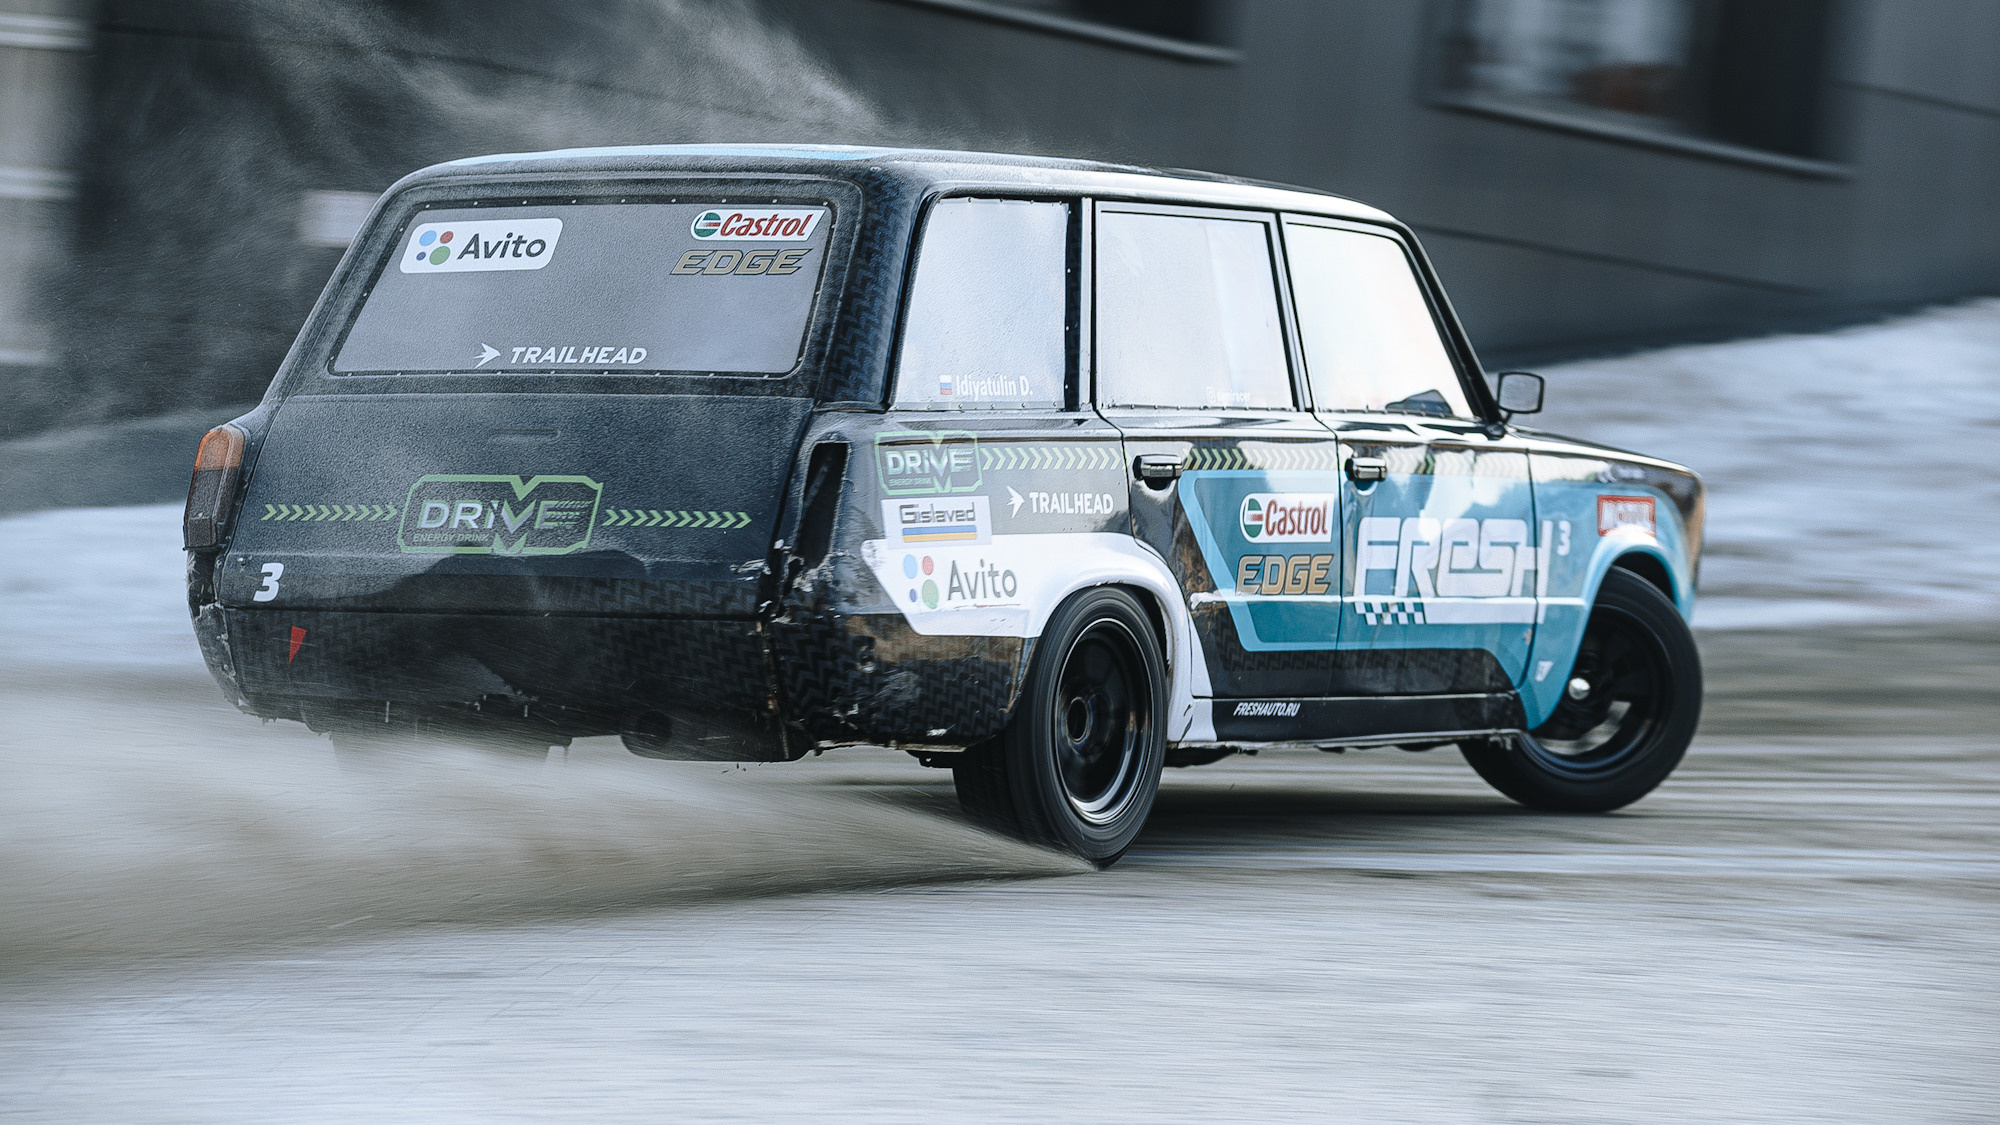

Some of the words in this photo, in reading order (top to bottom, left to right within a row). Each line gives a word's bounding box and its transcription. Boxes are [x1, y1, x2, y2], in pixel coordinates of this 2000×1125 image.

[720, 213, 813, 237] Castrol
[457, 232, 546, 260] Avito
[669, 248, 813, 276] EDGE
[511, 346, 648, 364] TRAILHEAD
[956, 375, 1017, 401] Idiyatulin
[1019, 375, 1034, 396] D.
[899, 502, 976, 524] Gislaved
[1029, 492, 1114, 515] TRAILHEAD
[1265, 499, 1328, 536] Castrol
[412, 533, 455, 543] ENERGY
[456, 533, 490, 543] DRINK
[1557, 520, 1571, 556] 3
[253, 562, 285, 602] 3
[948, 559, 1018, 601] Avito
[1235, 554, 1335, 595] EDGE
[1233, 702, 1301, 717] FRESHAUTO.RU
